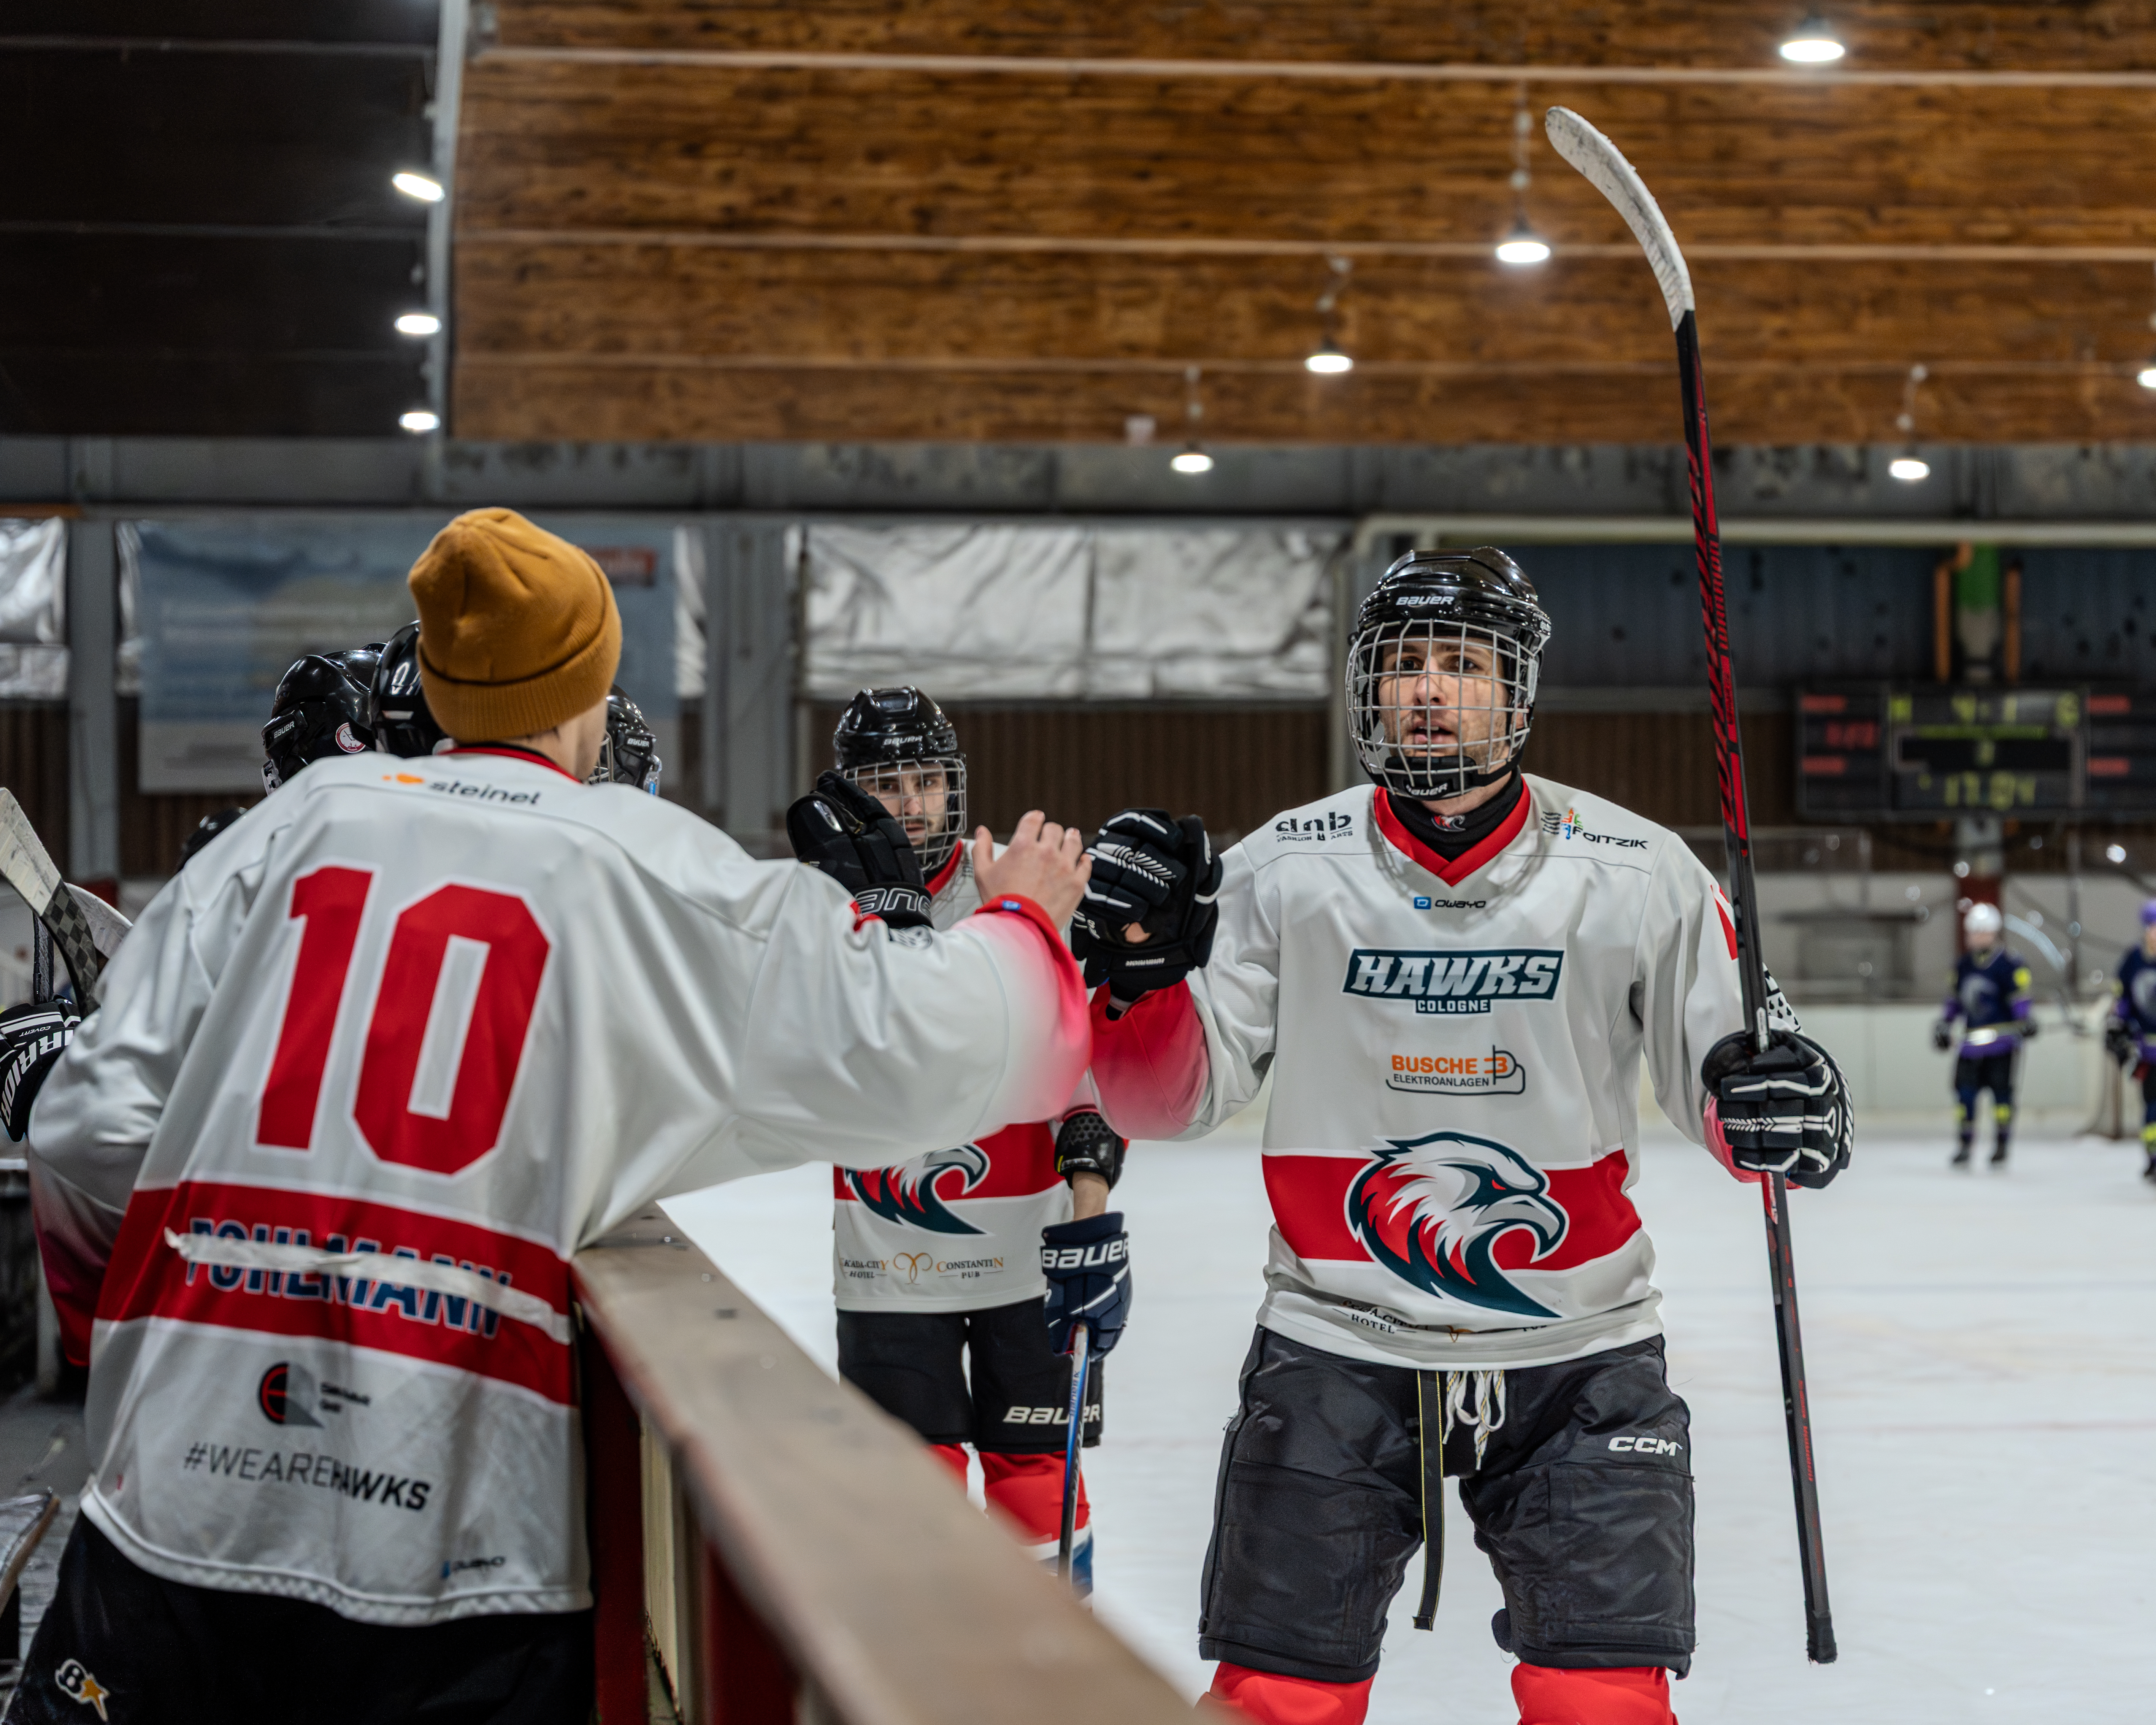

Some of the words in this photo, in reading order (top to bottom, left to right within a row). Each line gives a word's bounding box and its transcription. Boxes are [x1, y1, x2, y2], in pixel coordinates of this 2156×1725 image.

[1396, 596, 1455, 606] BAUER
[273, 720, 295, 739] BAUER
[430, 780, 542, 805] steinel
[1276, 811, 1352, 832] dnb
[1331, 830, 1353, 840] ARTS
[1572, 826, 1649, 850] FOITZIK
[1349, 954, 1560, 997] HAWKS
[1417, 999, 1490, 1013] COLOGNE
[254, 864, 552, 1178] 10
[19, 1026, 51, 1037] COVERT
[1391, 1054, 1478, 1074] BUSCHE
[1, 1030, 75, 1127] RRIOR
[1393, 1074, 1490, 1087] ELEKTROANLAGEN
[936, 1257, 1003, 1273] CONSTANTIN
[961, 1271, 980, 1279] PUB
[1351, 1314, 1395, 1334] HOTEL
[1002, 1403, 1101, 1425] BAUER
[1608, 1436, 1677, 1457] CCM
